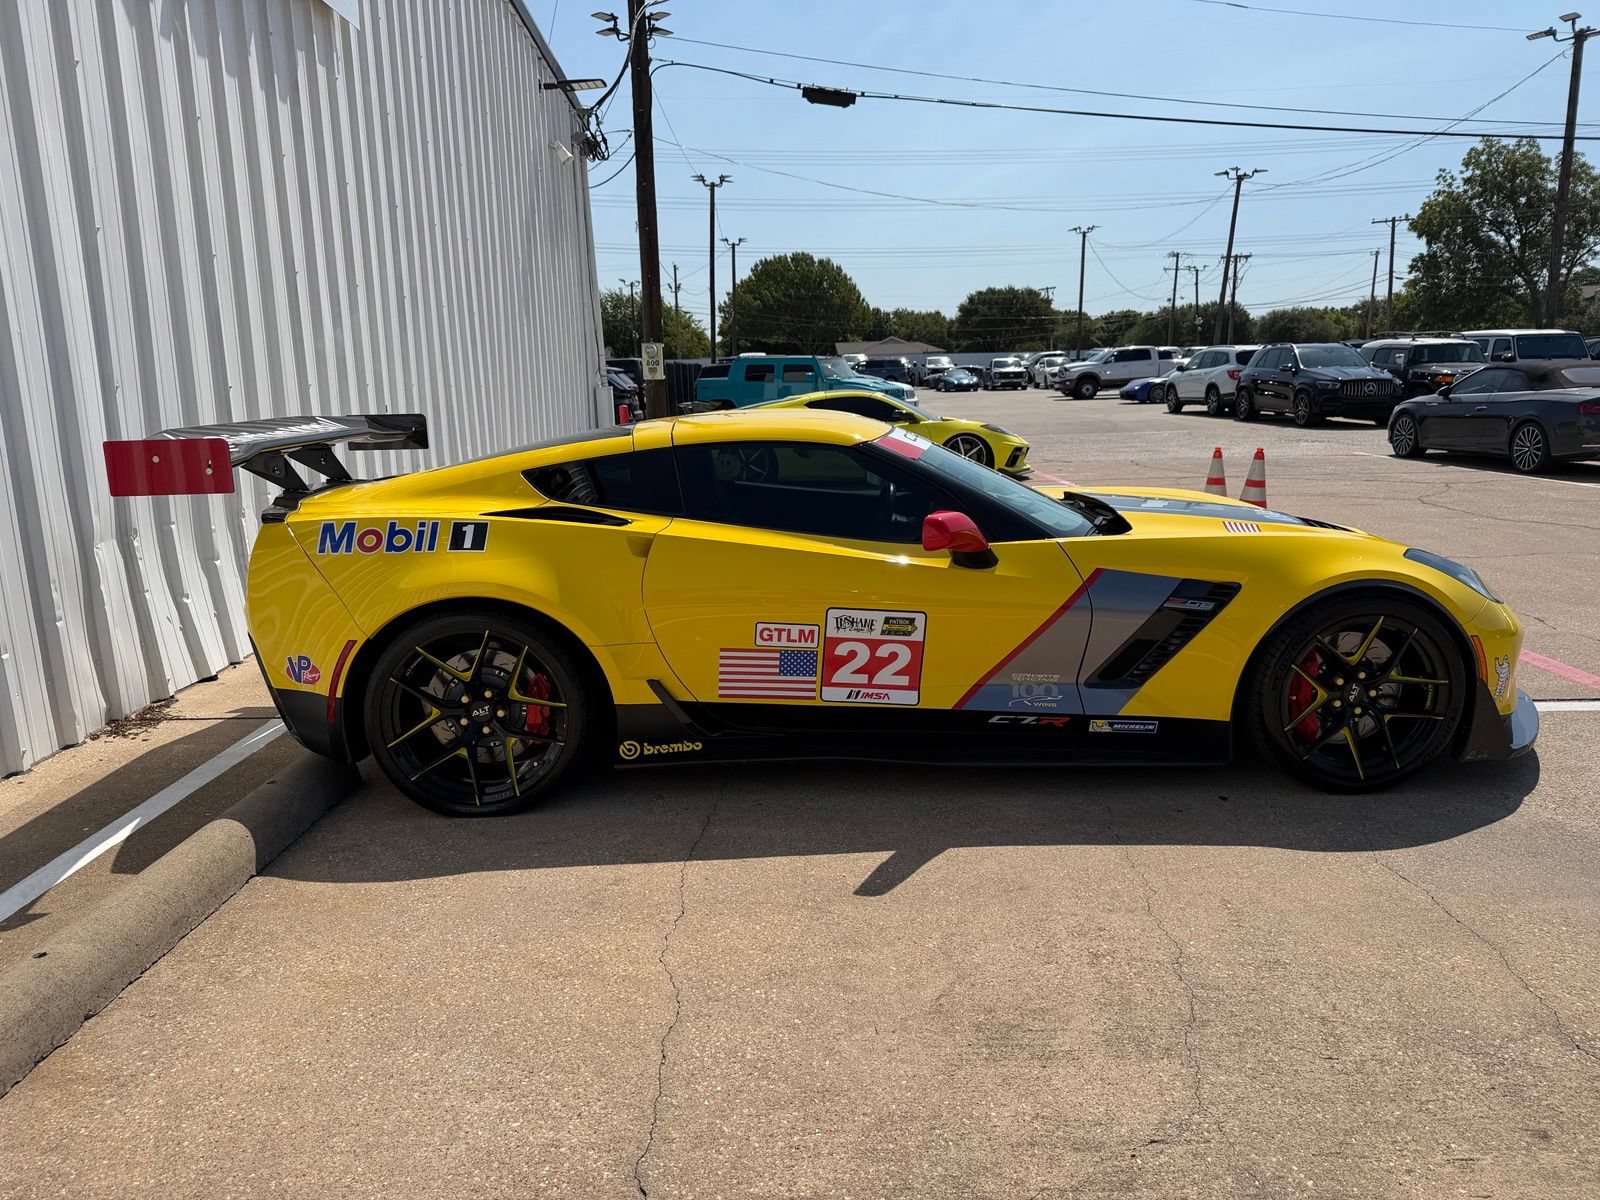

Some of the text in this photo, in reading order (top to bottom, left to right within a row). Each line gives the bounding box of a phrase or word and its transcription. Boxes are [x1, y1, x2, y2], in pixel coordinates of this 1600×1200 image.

[317, 520, 475, 555] Mobil 1
[759, 627, 815, 643] GTLM
[286, 655, 312, 684] VP
[831, 641, 912, 686] 22
[861, 692, 890, 700] IMSA
[1010, 683, 1059, 697] 100
[1349, 683, 1360, 702] ALT
[472, 705, 490, 717] ALT
[644, 741, 703, 755] brembo
